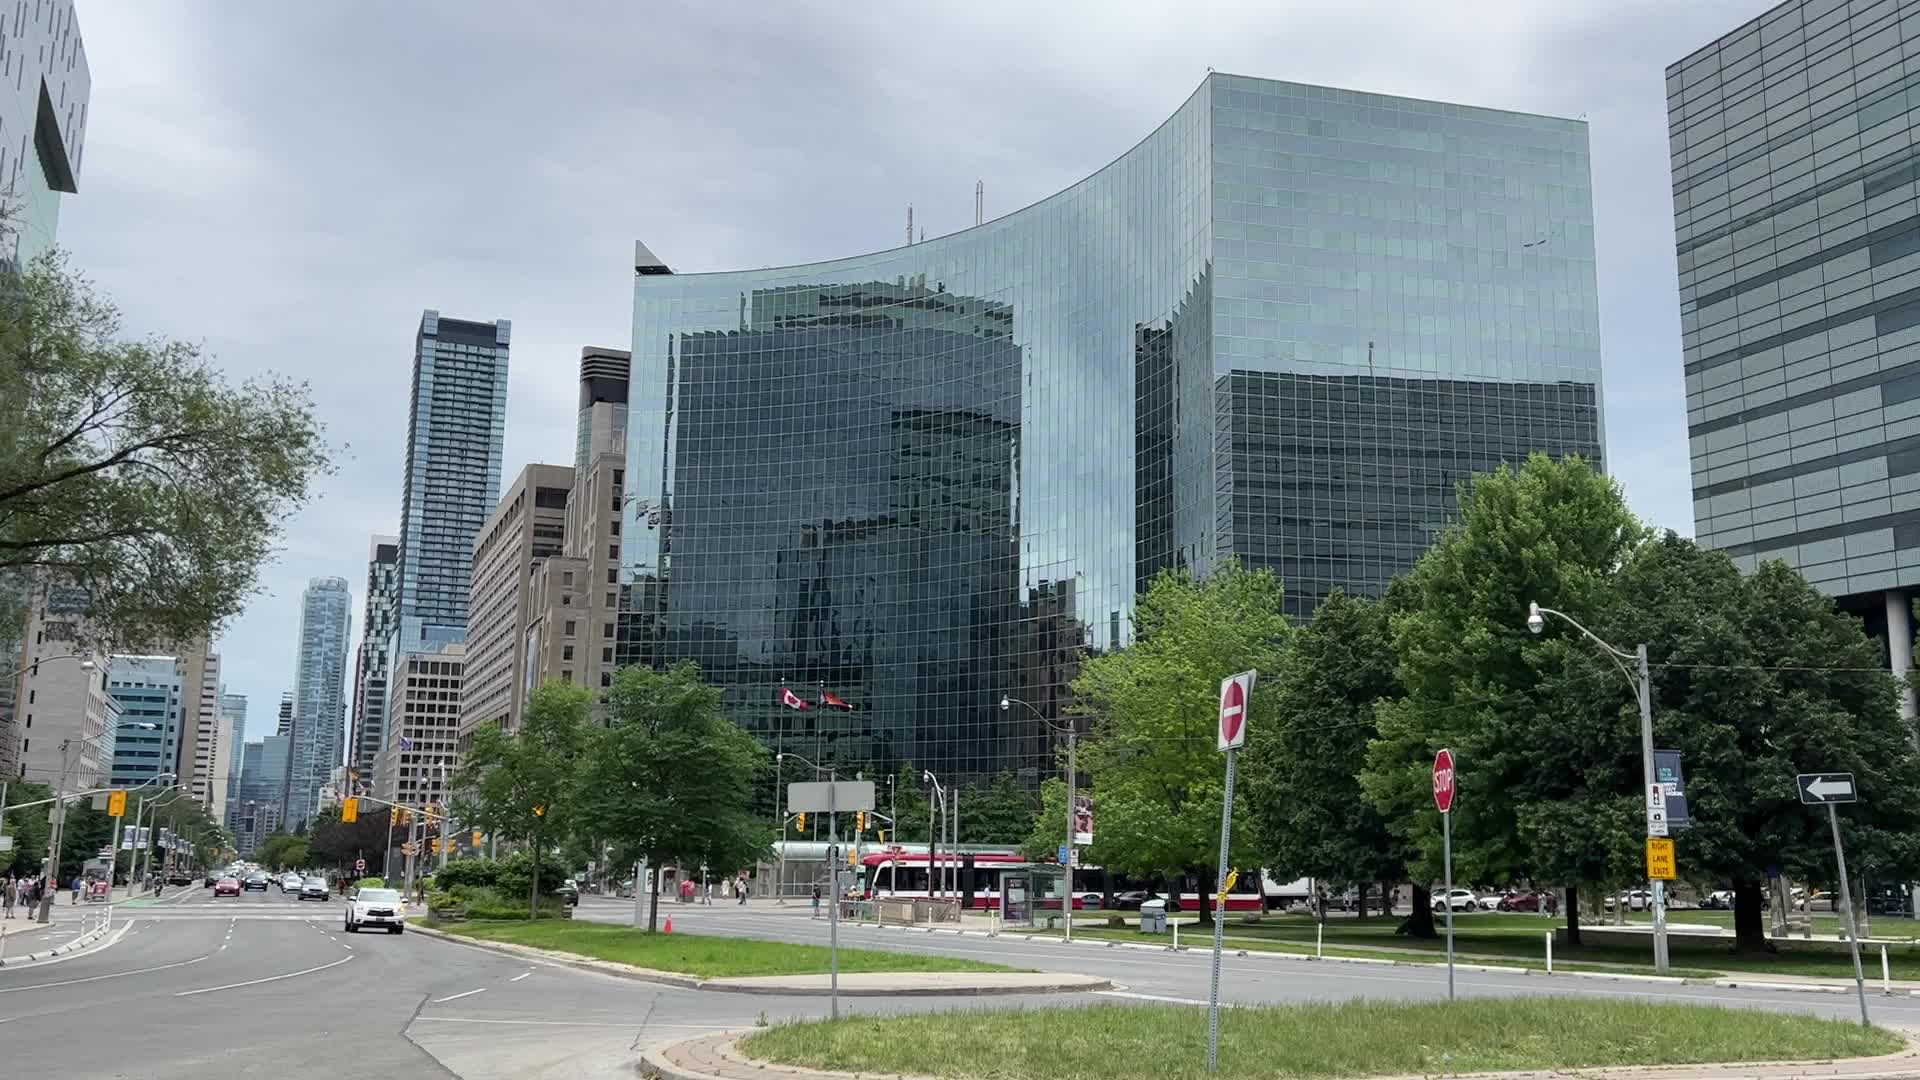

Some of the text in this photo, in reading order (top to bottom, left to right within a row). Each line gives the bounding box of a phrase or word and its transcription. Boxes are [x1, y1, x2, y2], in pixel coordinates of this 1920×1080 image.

[1435, 769, 1451, 794] STOP
[1652, 842, 1668, 850] RIGHT
[1652, 855, 1669, 863] LANE
[1653, 867, 1669, 876] EXITS
